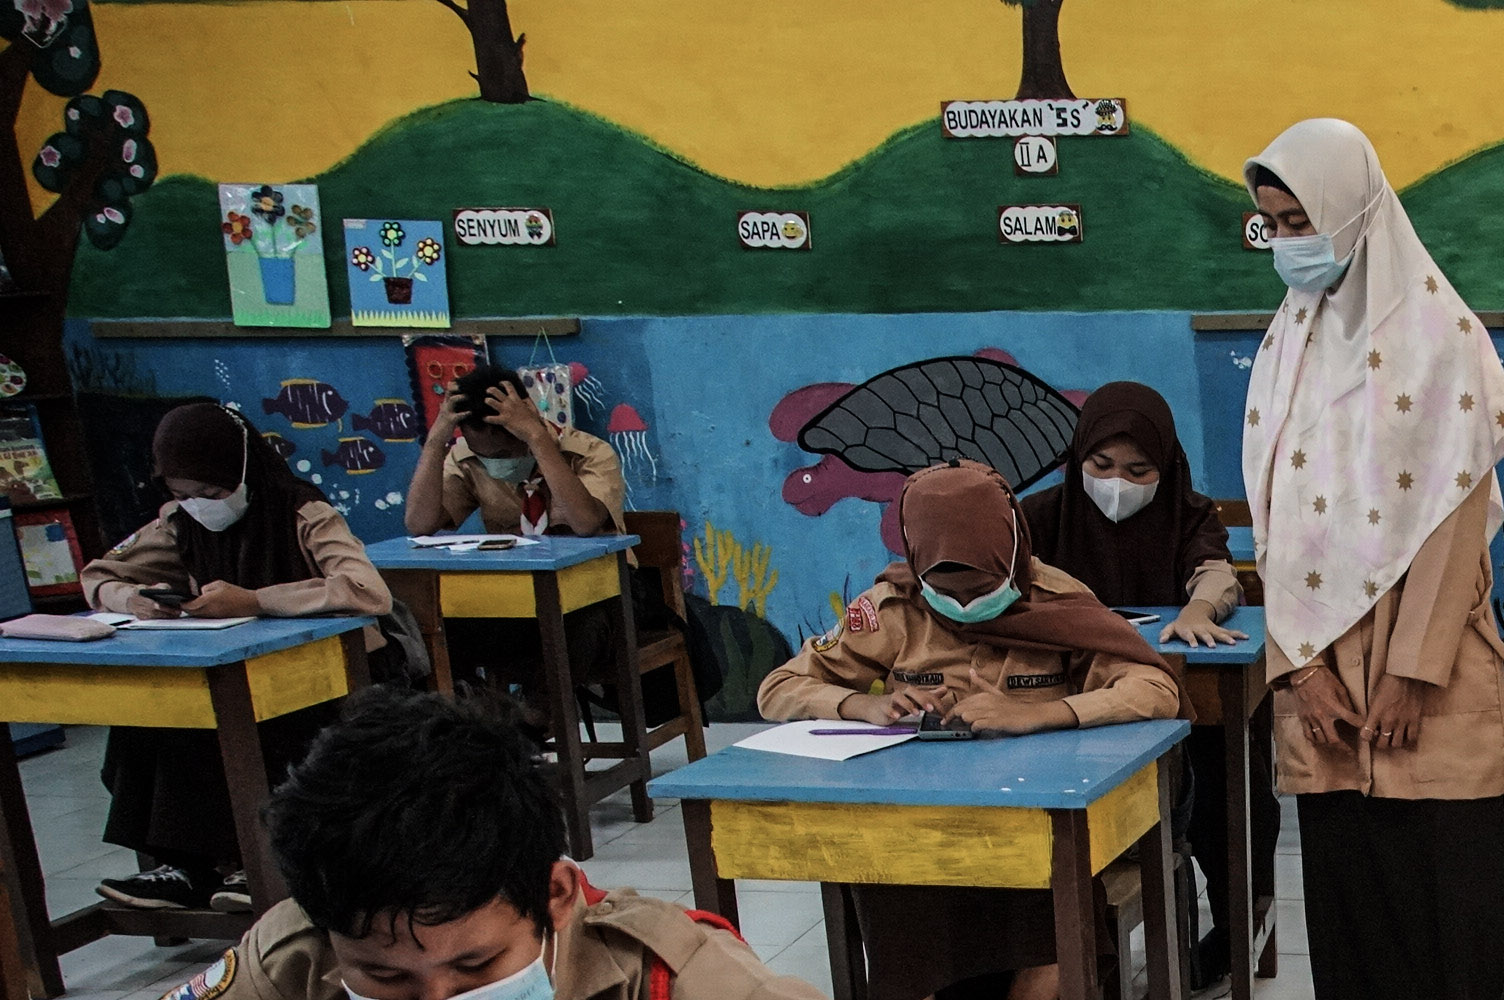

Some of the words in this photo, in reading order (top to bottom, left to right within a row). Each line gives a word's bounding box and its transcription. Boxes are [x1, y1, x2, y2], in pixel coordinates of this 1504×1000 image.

[946, 107, 1044, 130] BUDAYAKAN
[457, 218, 520, 238] SENYUM
[740, 220, 781, 240] SAPA
[1003, 216, 1057, 236] SALAM
